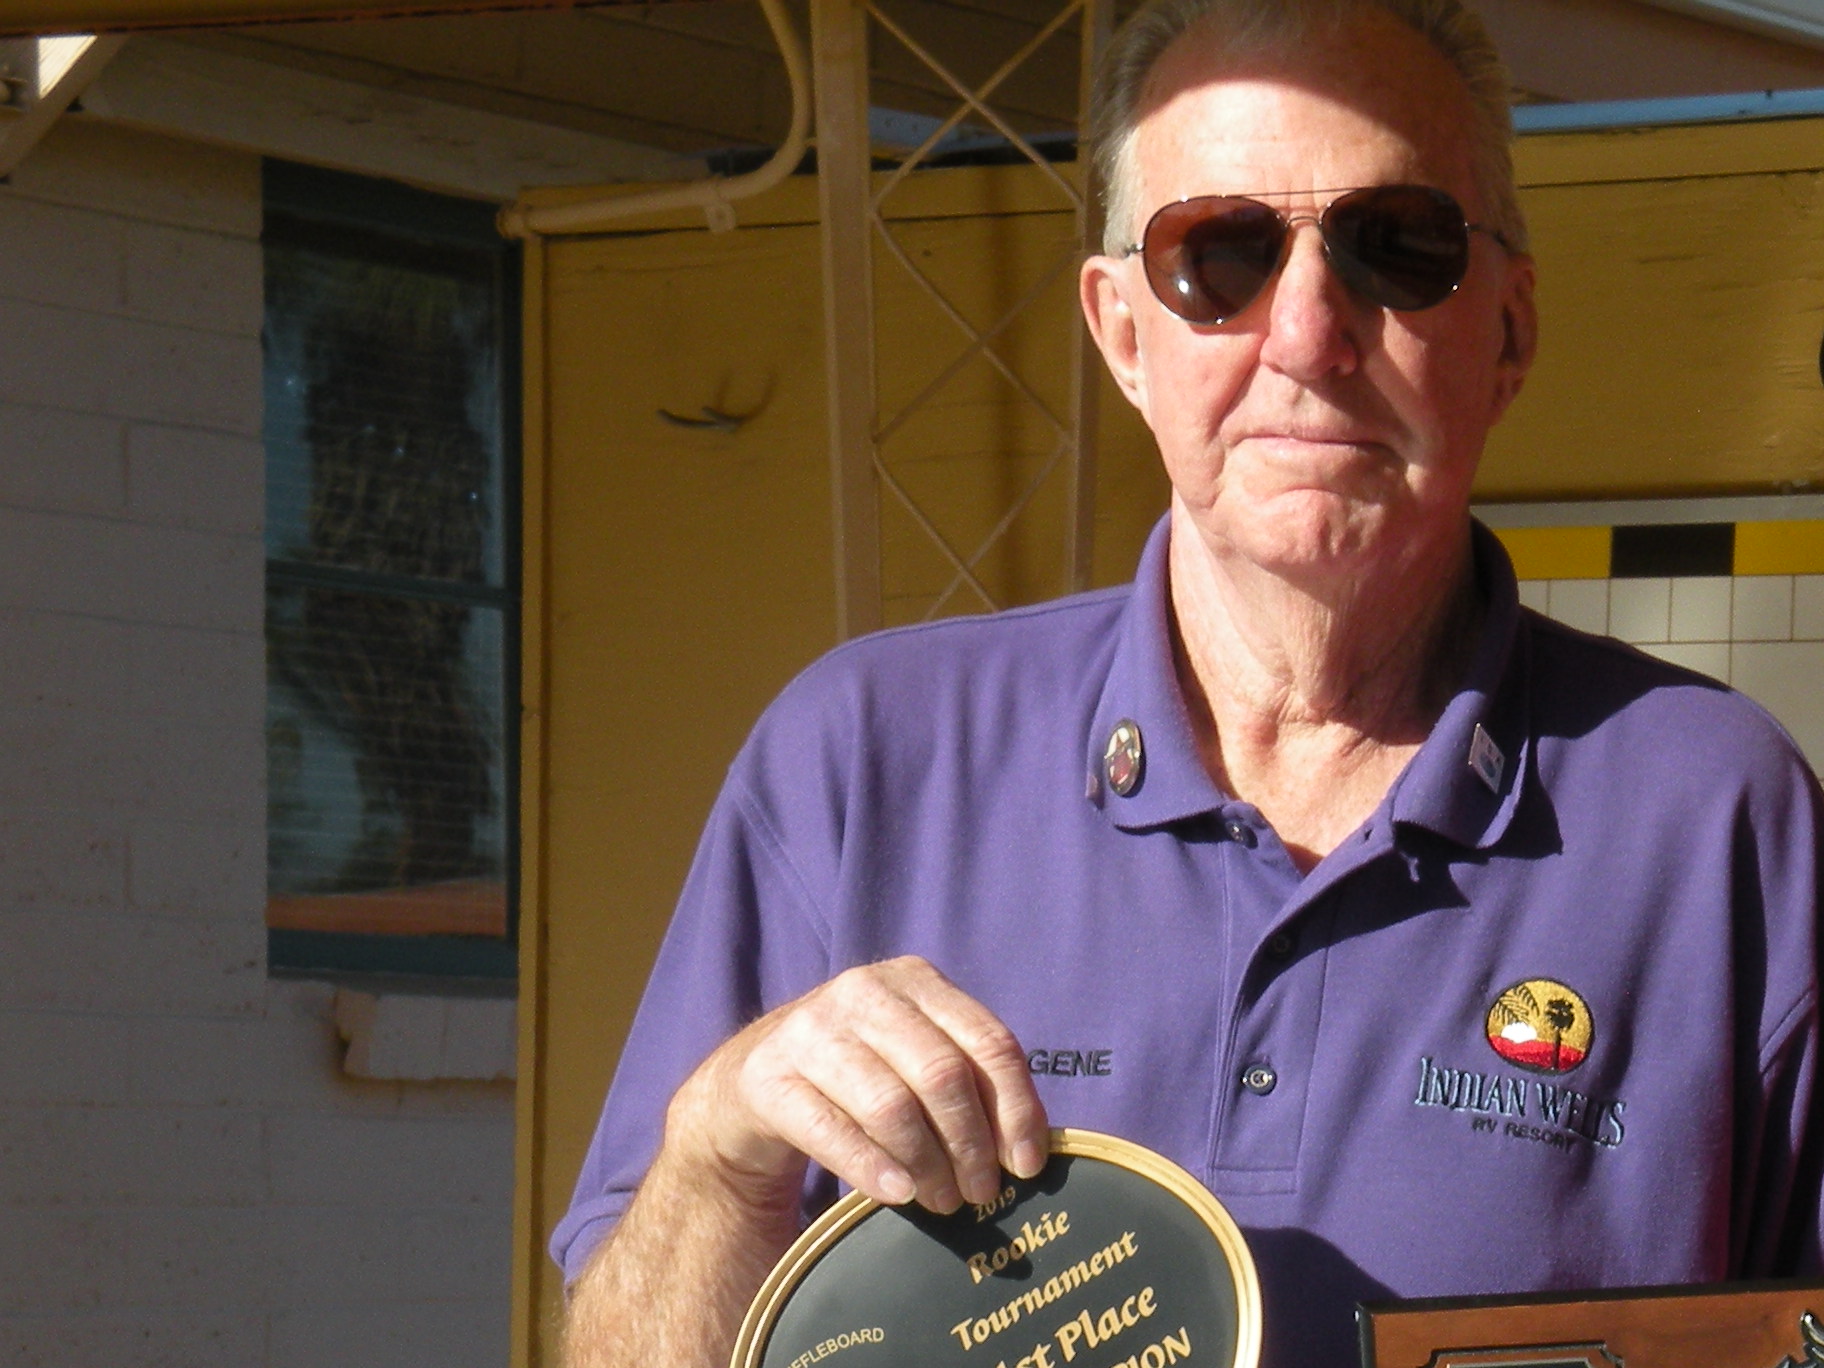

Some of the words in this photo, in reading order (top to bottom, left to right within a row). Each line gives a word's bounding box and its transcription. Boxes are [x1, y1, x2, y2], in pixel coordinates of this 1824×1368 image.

[1028, 1048, 1113, 1077] GENE
[1414, 1055, 1529, 1119] INDIAN
[1471, 1117, 1499, 1134] RV
[1505, 1120, 1577, 1154] RESORT
[973, 1185, 1017, 1223] 2019
[966, 1210, 1071, 1285] Rookie
[950, 1227, 1139, 1352] Tournament
[1056, 1286, 1158, 1362] Place
